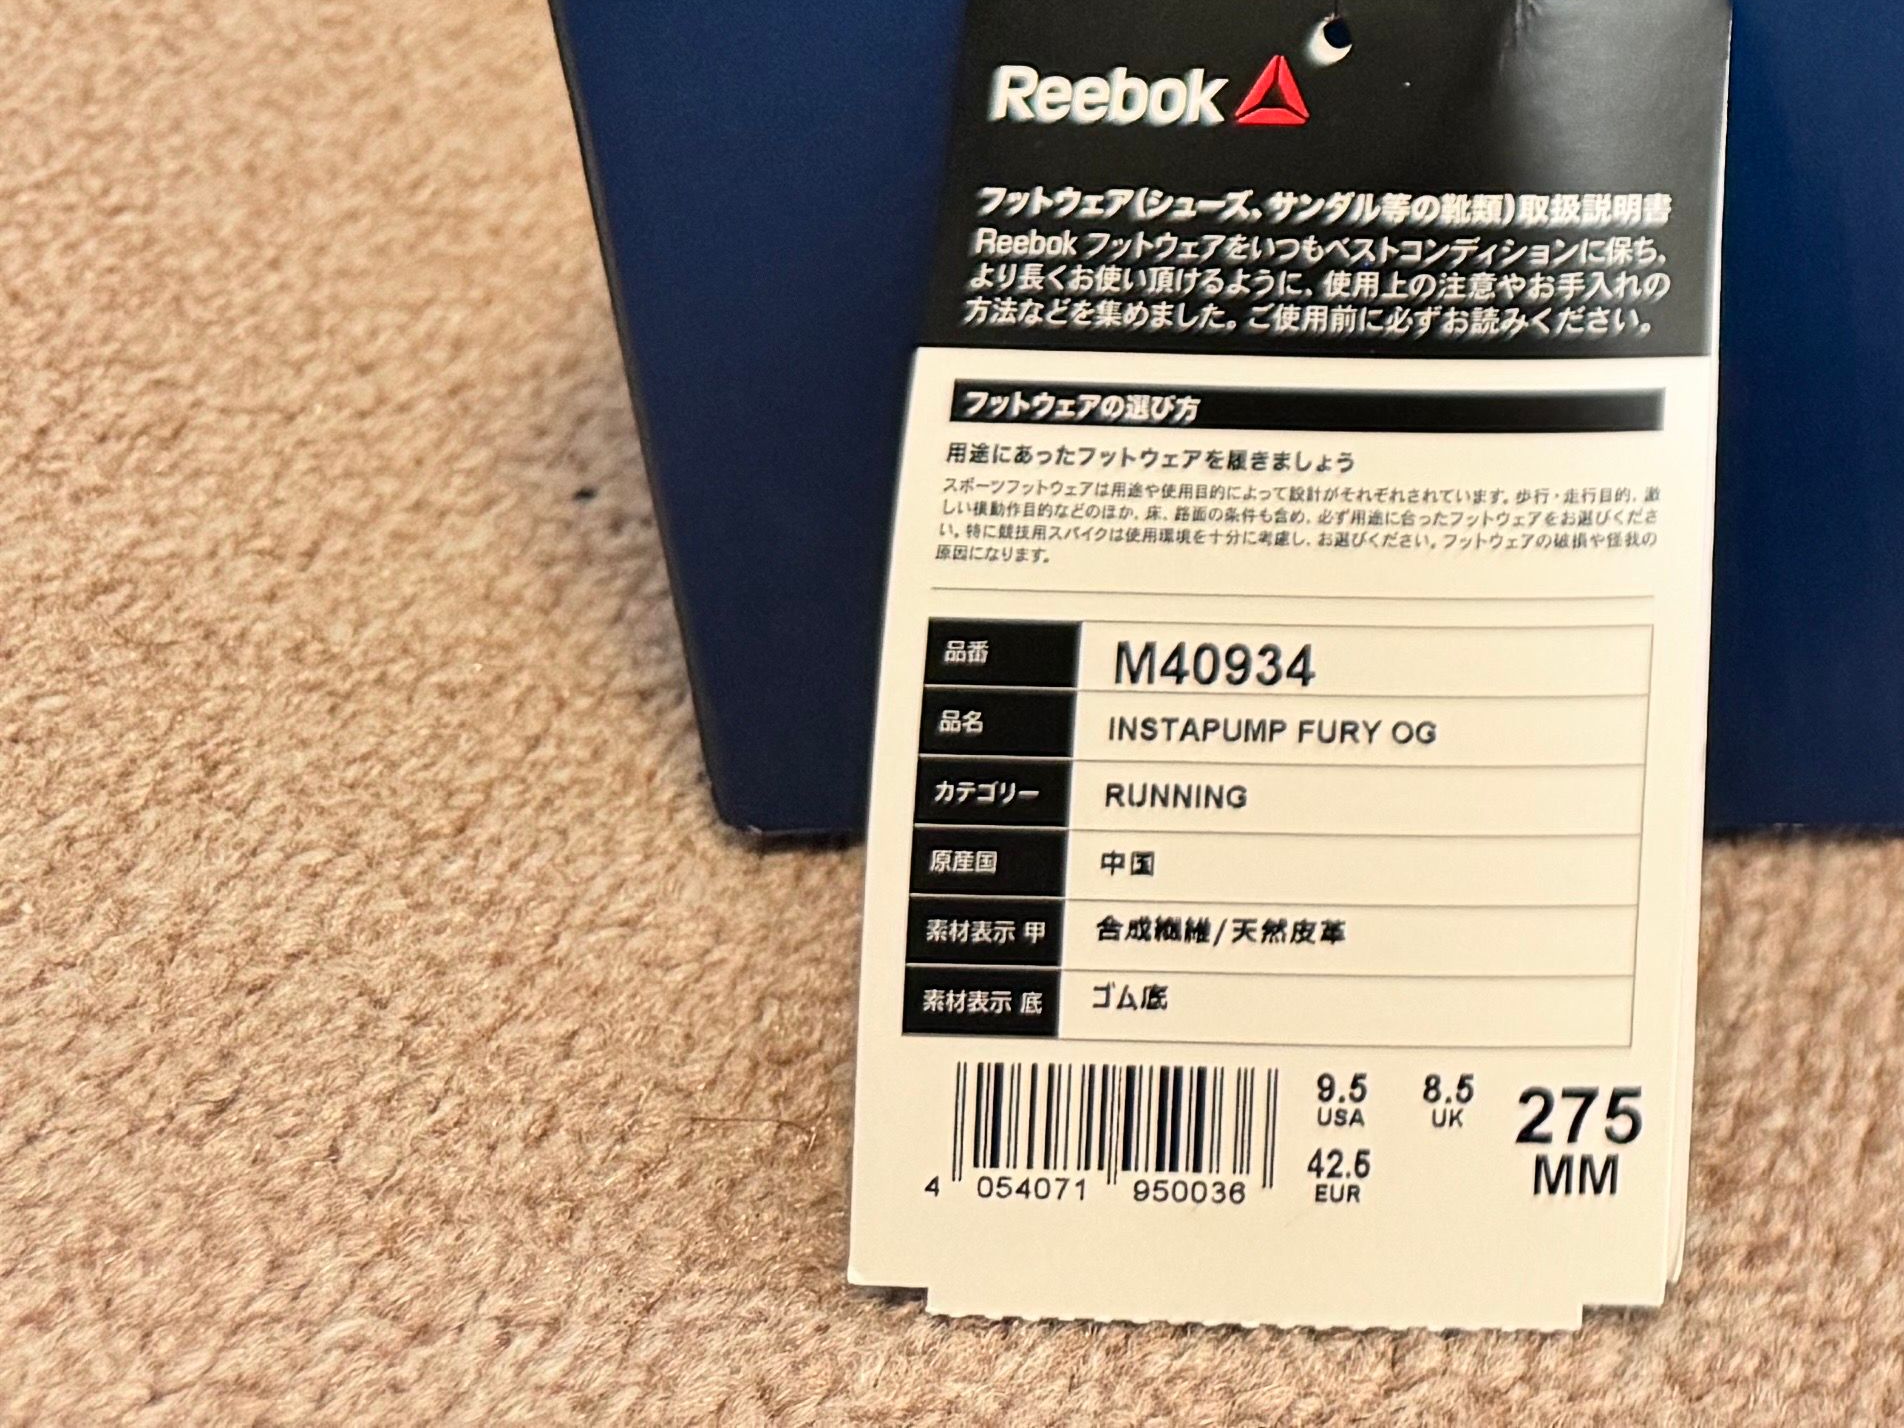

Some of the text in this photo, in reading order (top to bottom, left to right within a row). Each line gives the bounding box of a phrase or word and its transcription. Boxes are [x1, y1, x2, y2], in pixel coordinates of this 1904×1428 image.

[988, 64, 1230, 126] Reebok
[973, 227, 1078, 257] Reebok
[966, 391, 1201, 424] フットウェアの選び方
[946, 442, 1355, 473] 用途にあったフットウェアを履きましょう
[935, 544, 1051, 564] 原因になります。
[943, 640, 989, 664] 品番
[1114, 640, 1316, 688] M40934
[938, 710, 985, 735] 品名
[1107, 715, 1438, 746] INSTAPUMP FURY OG
[933, 780, 1040, 805] カテゴリー
[1104, 782, 1249, 809] RUNNING
[929, 849, 998, 874] 原産国
[1100, 849, 1156, 877] 中国
[925, 917, 1046, 943] 素材表示 甲
[922, 988, 1042, 1014] 素材表示 底
[1092, 980, 1169, 1011] ゴム底
[1316, 1072, 1643, 1145] 9.5 8.5 275
[1316, 1107, 1464, 1128] USA UK
[1532, 1152, 1620, 1196] MM
[924, 1175, 1247, 1205] 4 054071 950036
[1314, 1183, 1362, 1204] EUR
